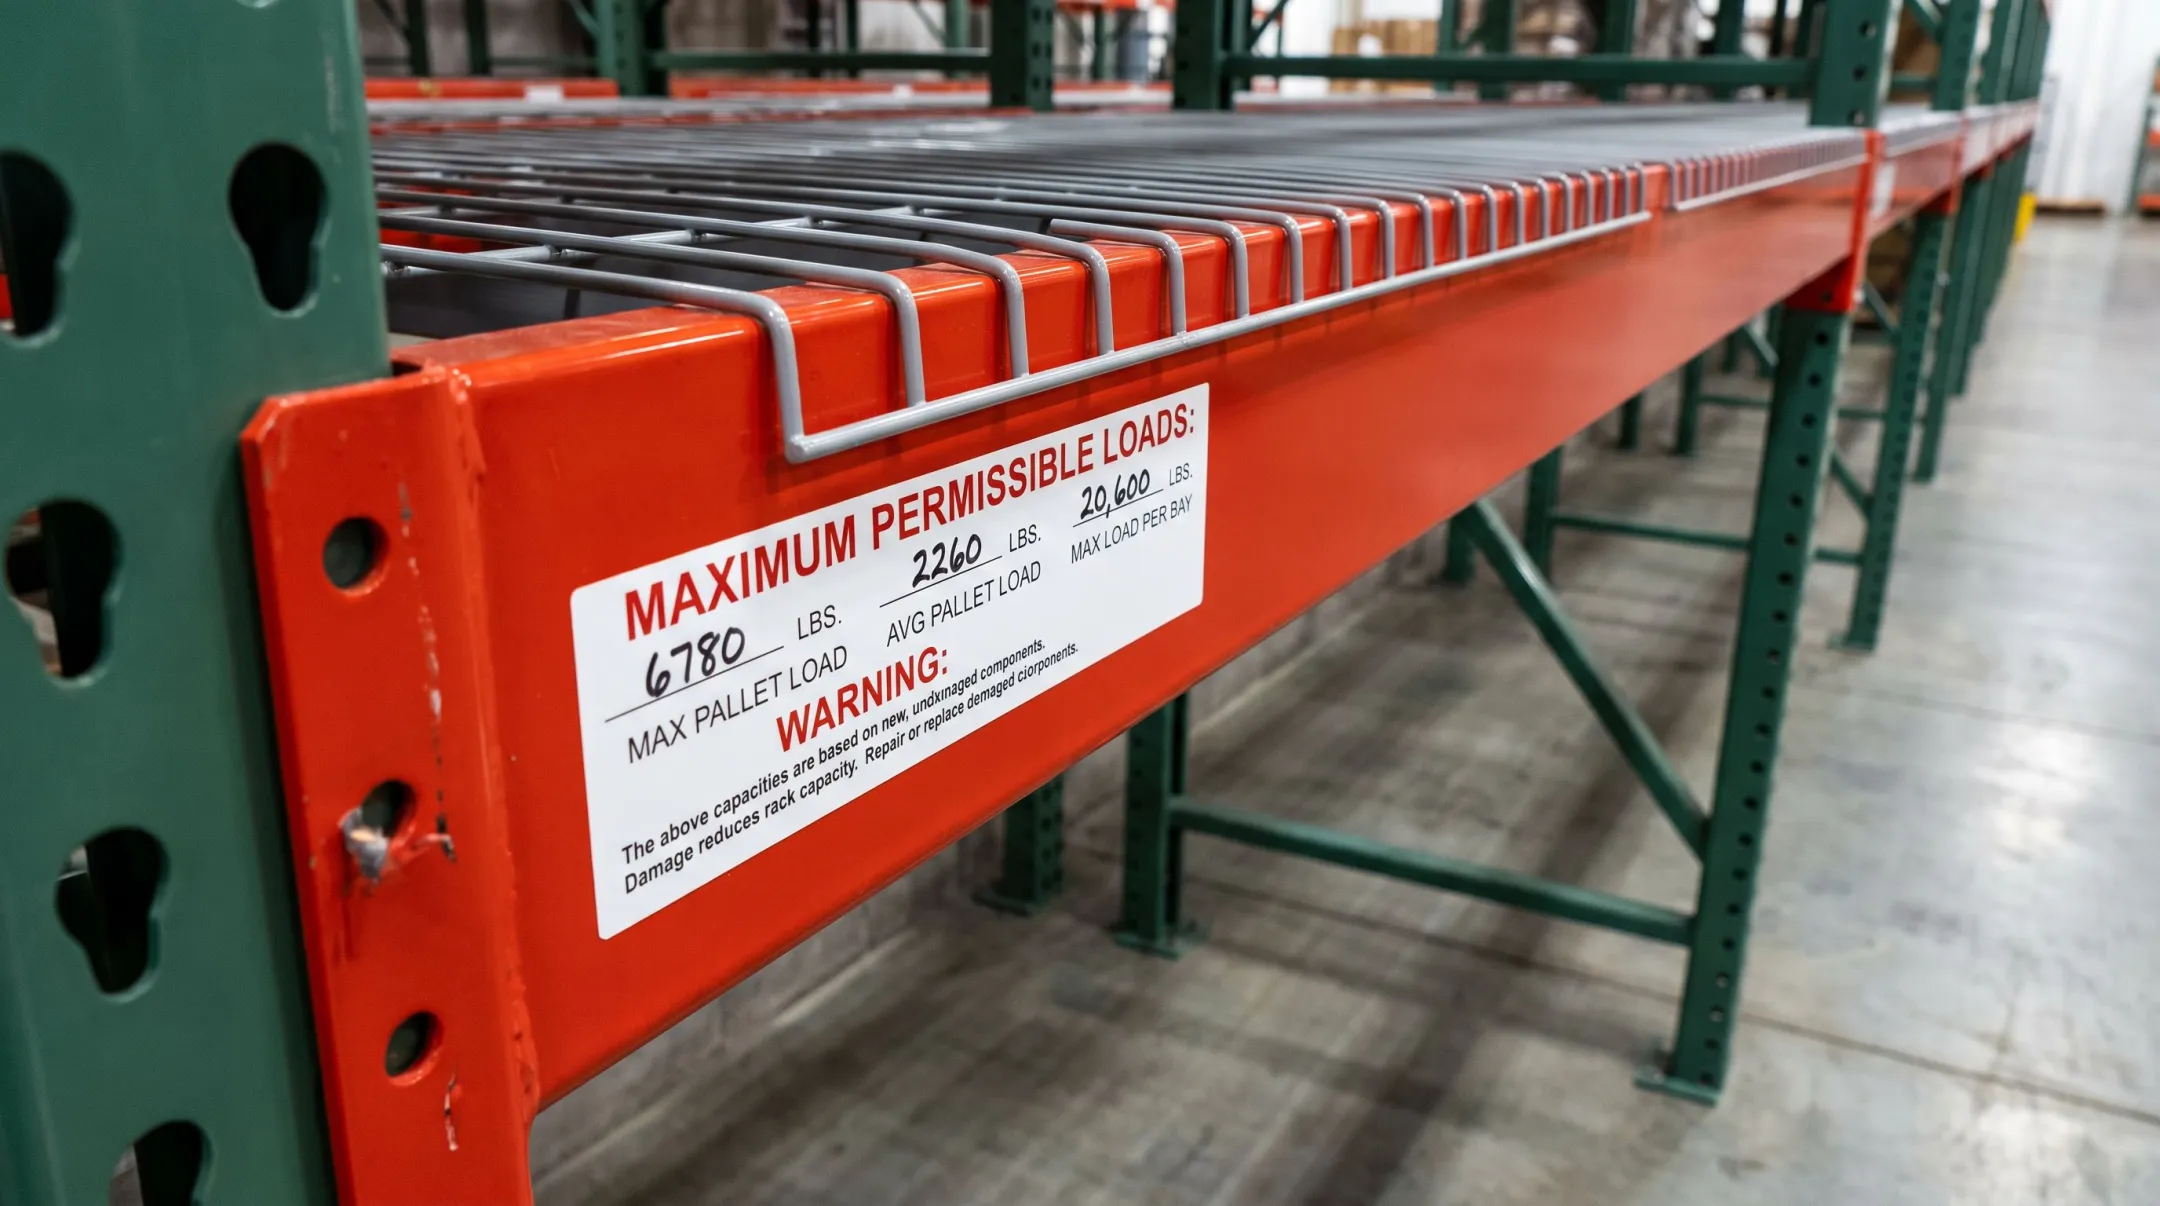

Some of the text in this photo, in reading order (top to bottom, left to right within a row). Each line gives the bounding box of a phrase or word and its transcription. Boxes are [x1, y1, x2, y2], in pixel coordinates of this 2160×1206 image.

[1080, 468, 1151, 520] 20,600
[1169, 462, 1194, 487] LBS.
[625, 403, 1195, 642] MAXIMUM PERMISSIBLE LOADS:
[1009, 523, 1042, 553] LBS.
[1071, 494, 1194, 564] MAX LOAD PER BAY
[911, 533, 982, 588] 2260
[797, 604, 843, 641] LBS.
[886, 560, 1042, 648] AVG PALLET LOAD
[645, 626, 746, 698] 6780
[628, 645, 848, 764] MAX PALLET LOAD
[775, 645, 949, 753] WARNING:
[621, 838, 656, 865] The
[659, 810, 710, 848] above
[713, 768, 790, 820] capacities
[793, 756, 816, 779] are
[818, 729, 860, 766] based
[862, 723, 879, 743] on
[881, 708, 910, 734] new,
[980, 638, 1046, 681] components.
[625, 846, 695, 896] Damage
[698, 810, 761, 855] reduces
[763, 788, 797, 820] rack
[799, 758, 859, 801] capacity.
[864, 731, 907, 766] Repair
[908, 724, 922, 742] or
[923, 702, 966, 735] replace
[967, 671, 1016, 711] demaged
